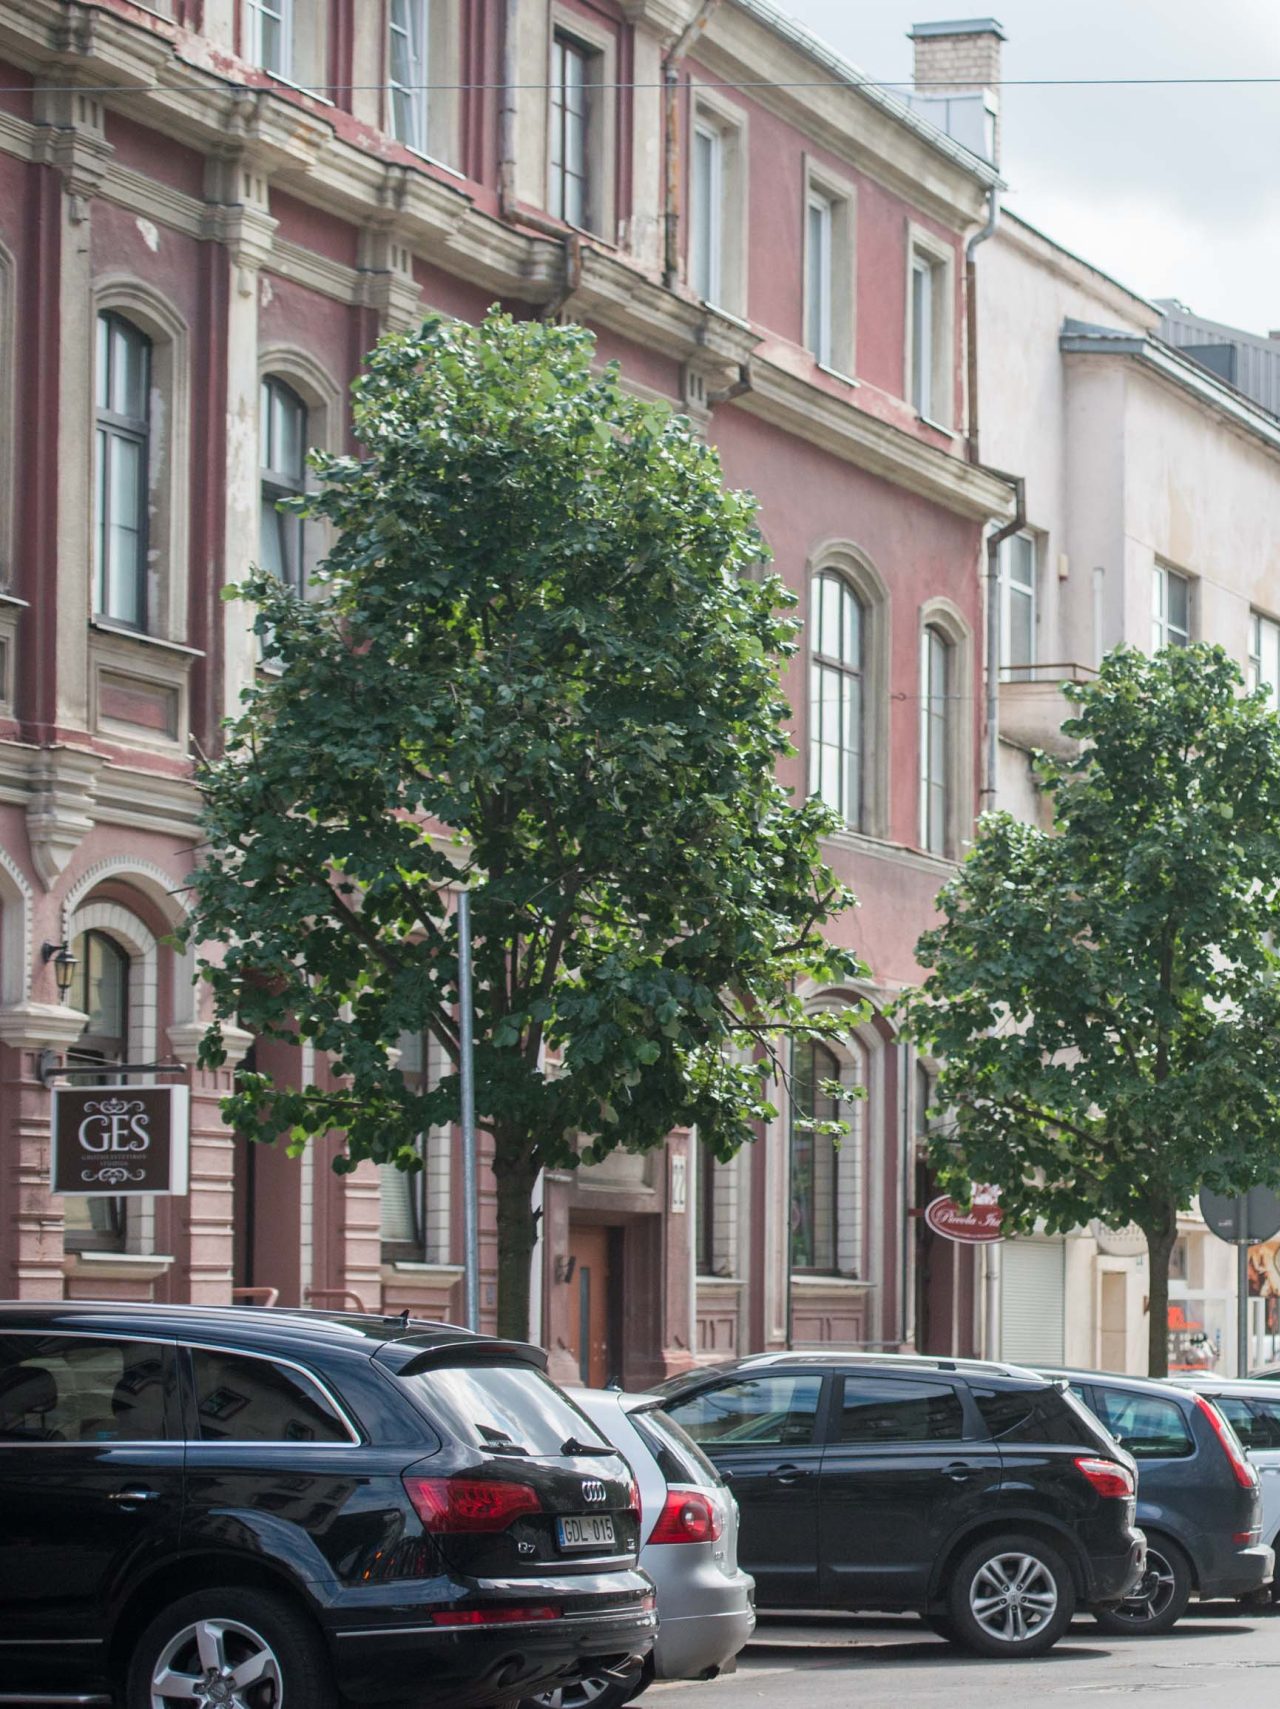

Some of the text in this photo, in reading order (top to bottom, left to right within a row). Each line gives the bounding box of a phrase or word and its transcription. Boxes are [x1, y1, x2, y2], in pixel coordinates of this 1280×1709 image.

[79, 1114, 149, 1152] GES
[564, 1518, 614, 1543] GDL 015
